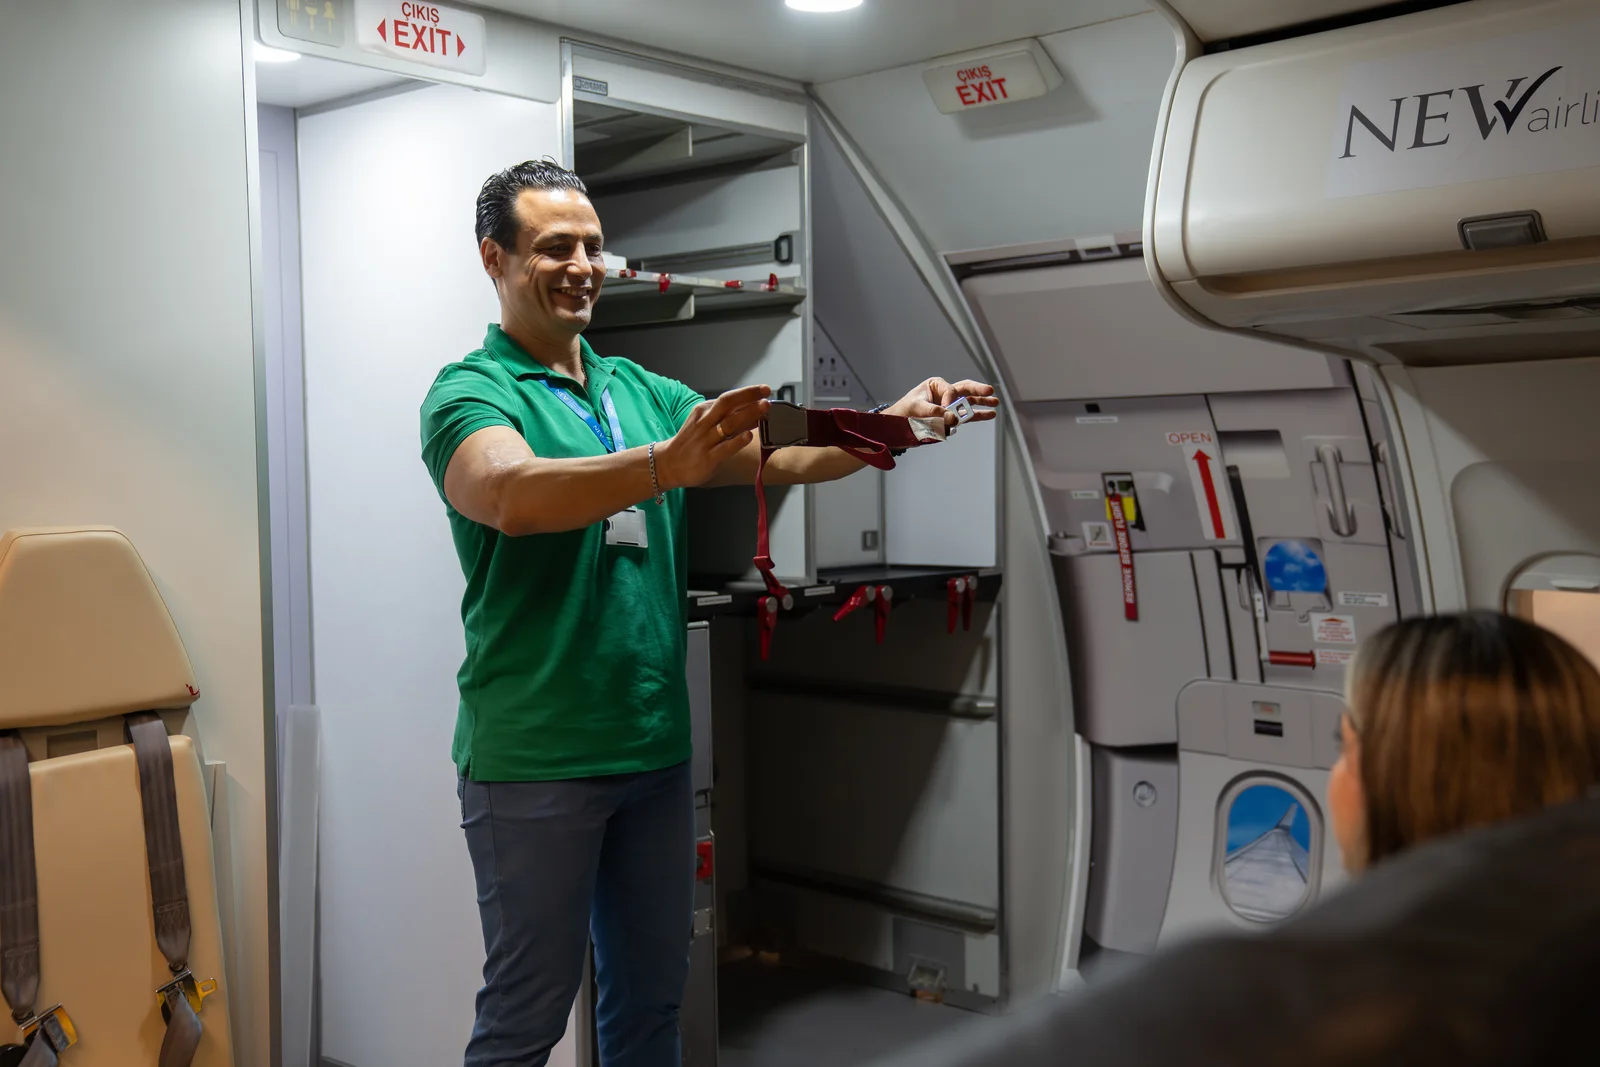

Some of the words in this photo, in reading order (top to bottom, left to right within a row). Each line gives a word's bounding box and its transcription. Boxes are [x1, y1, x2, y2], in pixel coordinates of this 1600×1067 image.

[401, 2, 440, 27] ÇIKIŞ
[394, 19, 452, 56] EXIT
[956, 65, 992, 84] ÇIKIŞ
[955, 78, 1009, 106] EXIT
[1338, 66, 1563, 159] NEW
[1168, 432, 1213, 445] OPEN
[1110, 500, 1126, 529] FLIGHT
[1116, 531, 1131, 565] BEFORE
[1122, 567, 1135, 604] REMOVE
